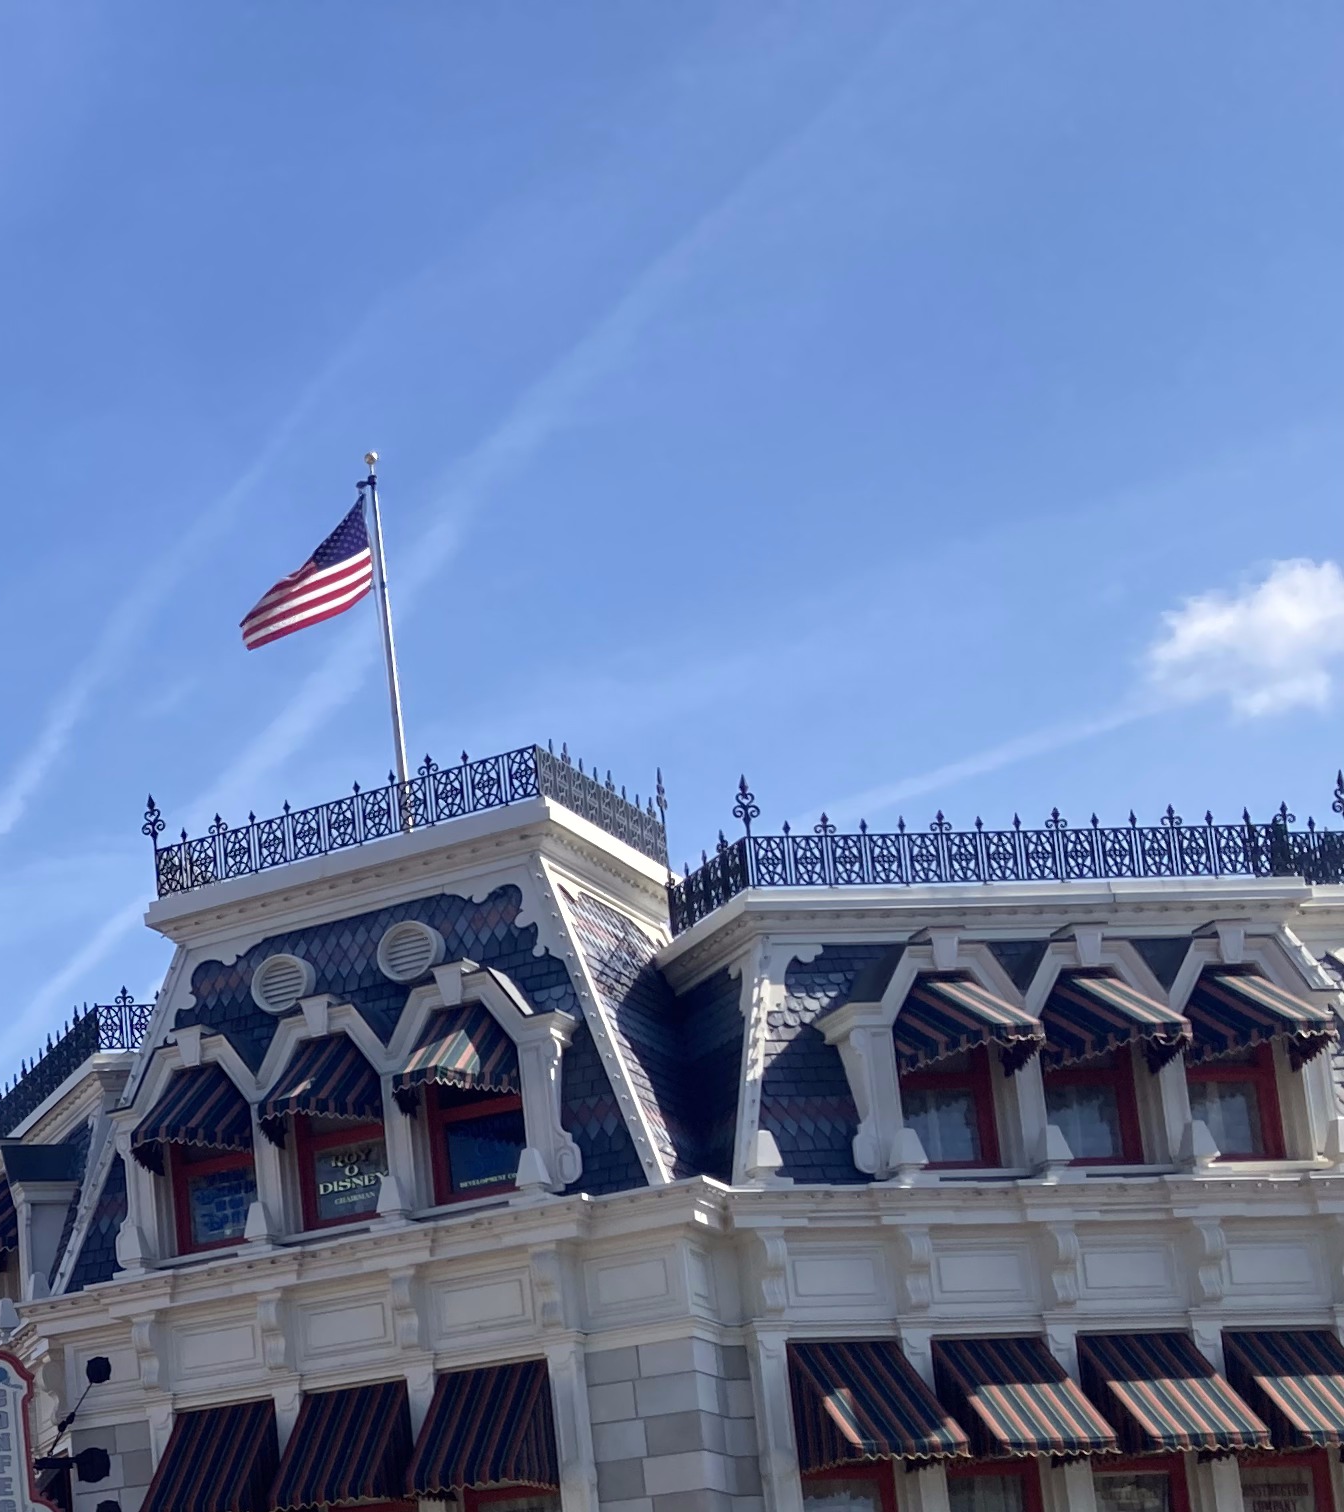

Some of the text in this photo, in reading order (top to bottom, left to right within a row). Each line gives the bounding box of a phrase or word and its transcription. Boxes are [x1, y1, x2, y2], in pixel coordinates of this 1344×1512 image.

[331, 1147, 372, 1168] ROY
[318, 1170, 389, 1196] DISNEY
[334, 1191, 376, 1206] CHAIRMAN
